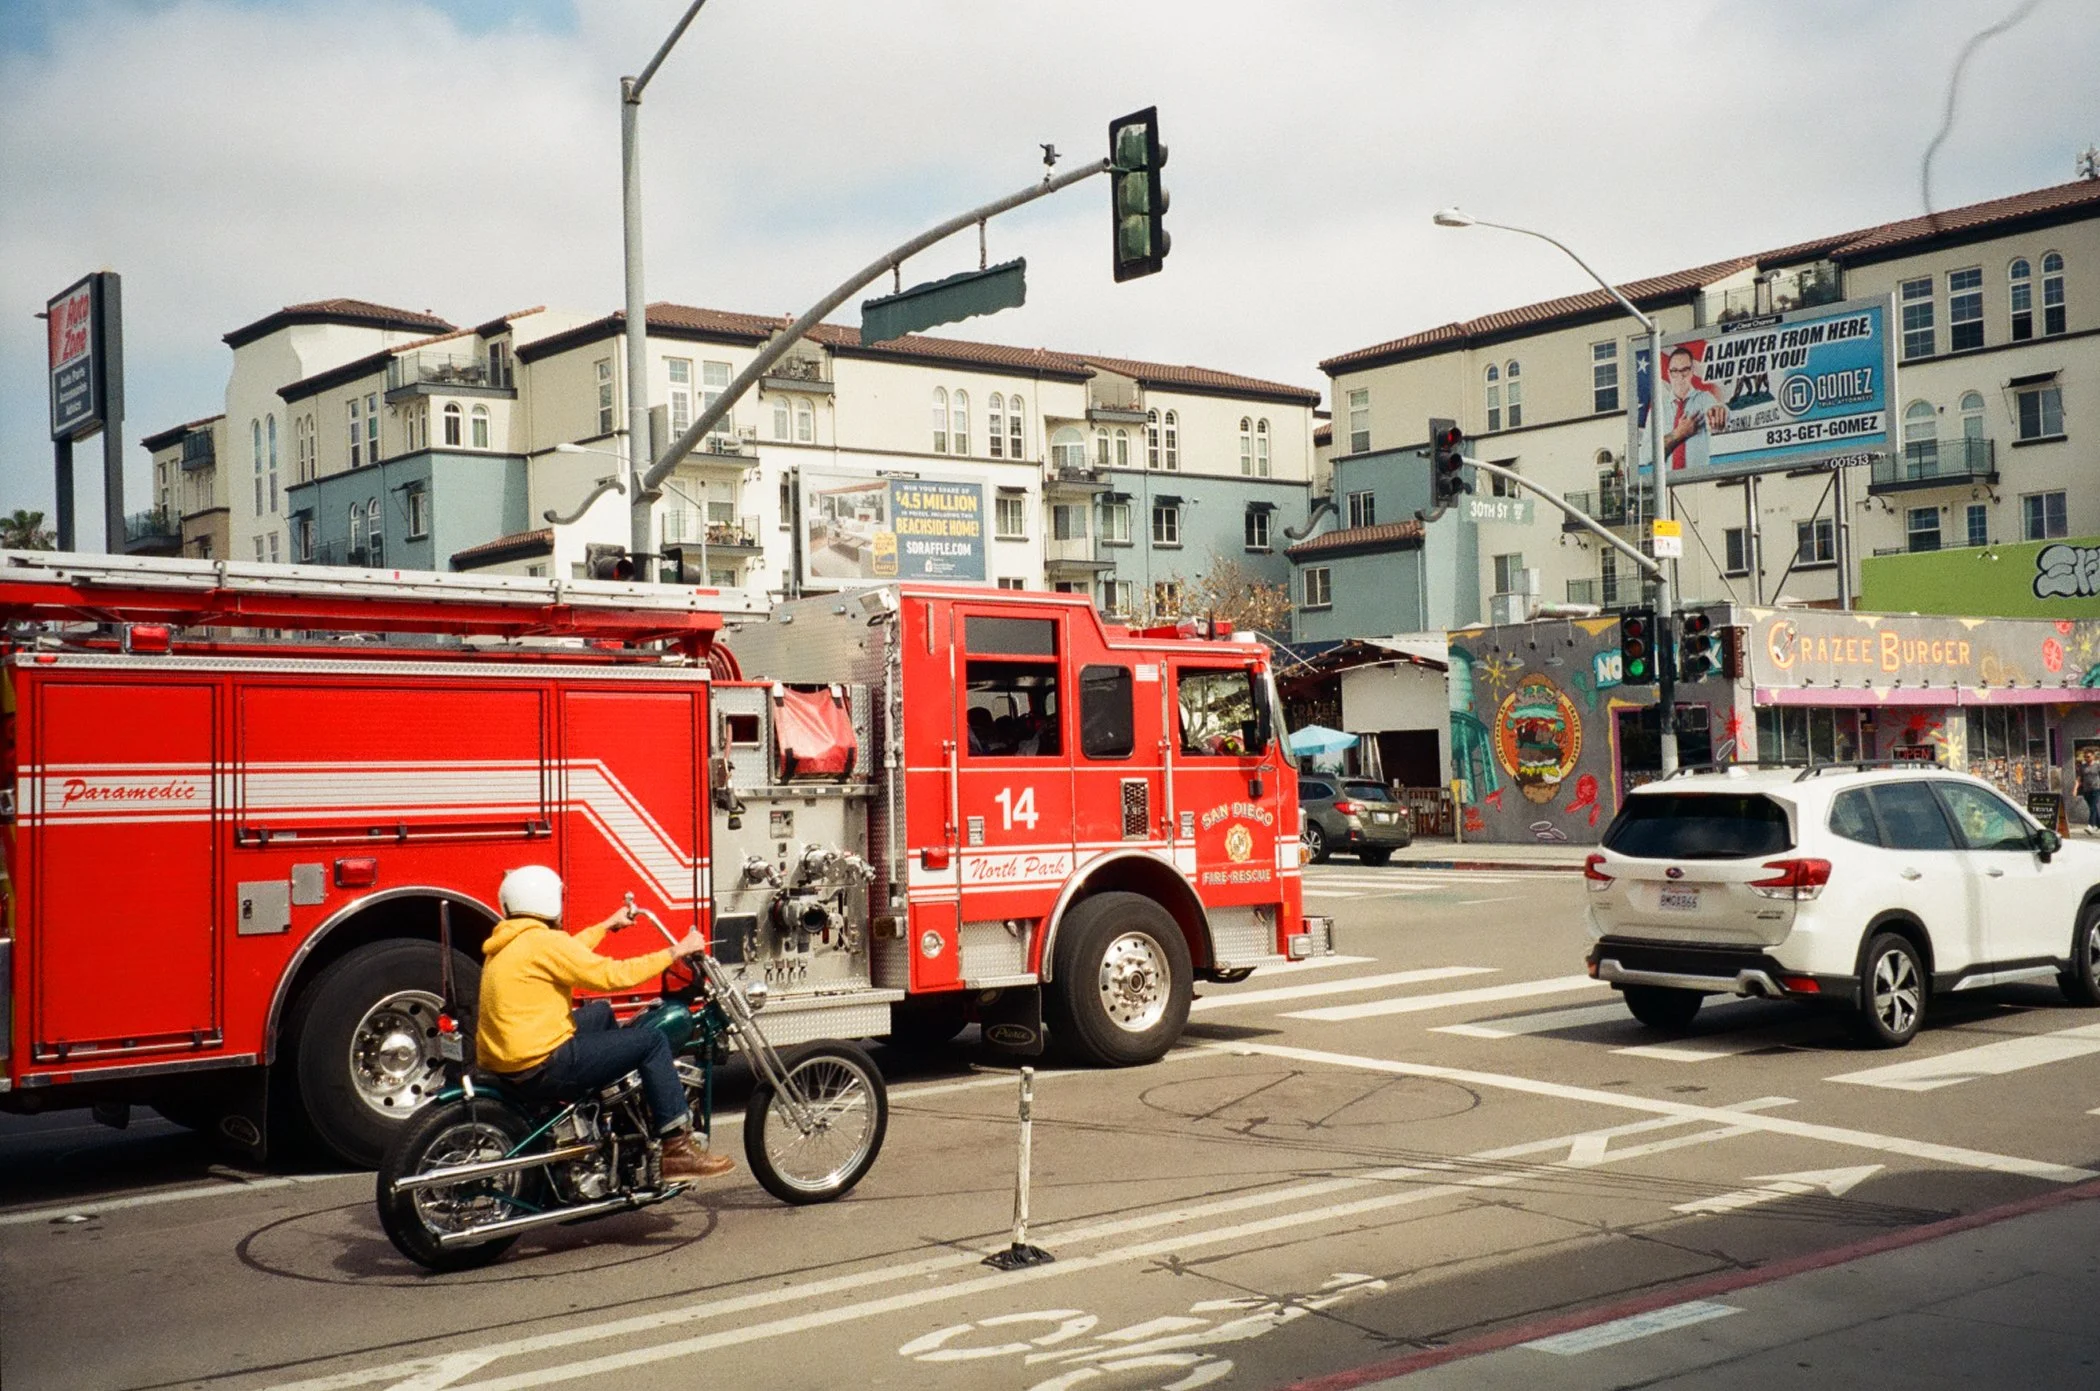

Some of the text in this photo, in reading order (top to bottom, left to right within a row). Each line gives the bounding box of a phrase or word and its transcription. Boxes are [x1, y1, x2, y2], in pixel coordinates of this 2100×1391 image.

[66, 293, 89, 328] Auto
[62, 327, 87, 361] Zone
[1704, 317, 1871, 363] A LAWYER FROM HERE,
[1704, 347, 1807, 381] AND FOR YOU!
[1817, 367, 1873, 400] GOMEZ
[1766, 416, 1878, 445] 833-GET-GOMEZ
[1830, 454, 1869, 469] 001513
[895, 490, 978, 512] $4.5 MILLION
[1470, 500, 1496, 518] 30TH
[1496, 502, 1508, 519] ST
[895, 516, 979, 537] BEACHSIDE HOME!
[906, 540, 972, 556] SDRAFFLE.COM
[1767, 619, 1874, 671] CRAZEE
[1879, 629, 1972, 673] BURGER
[63, 778, 196, 809] Paramedic
[994, 787, 1039, 830] 14
[1201, 801, 1274, 831] SAN DIEGO
[970, 855, 1065, 880] North Park
